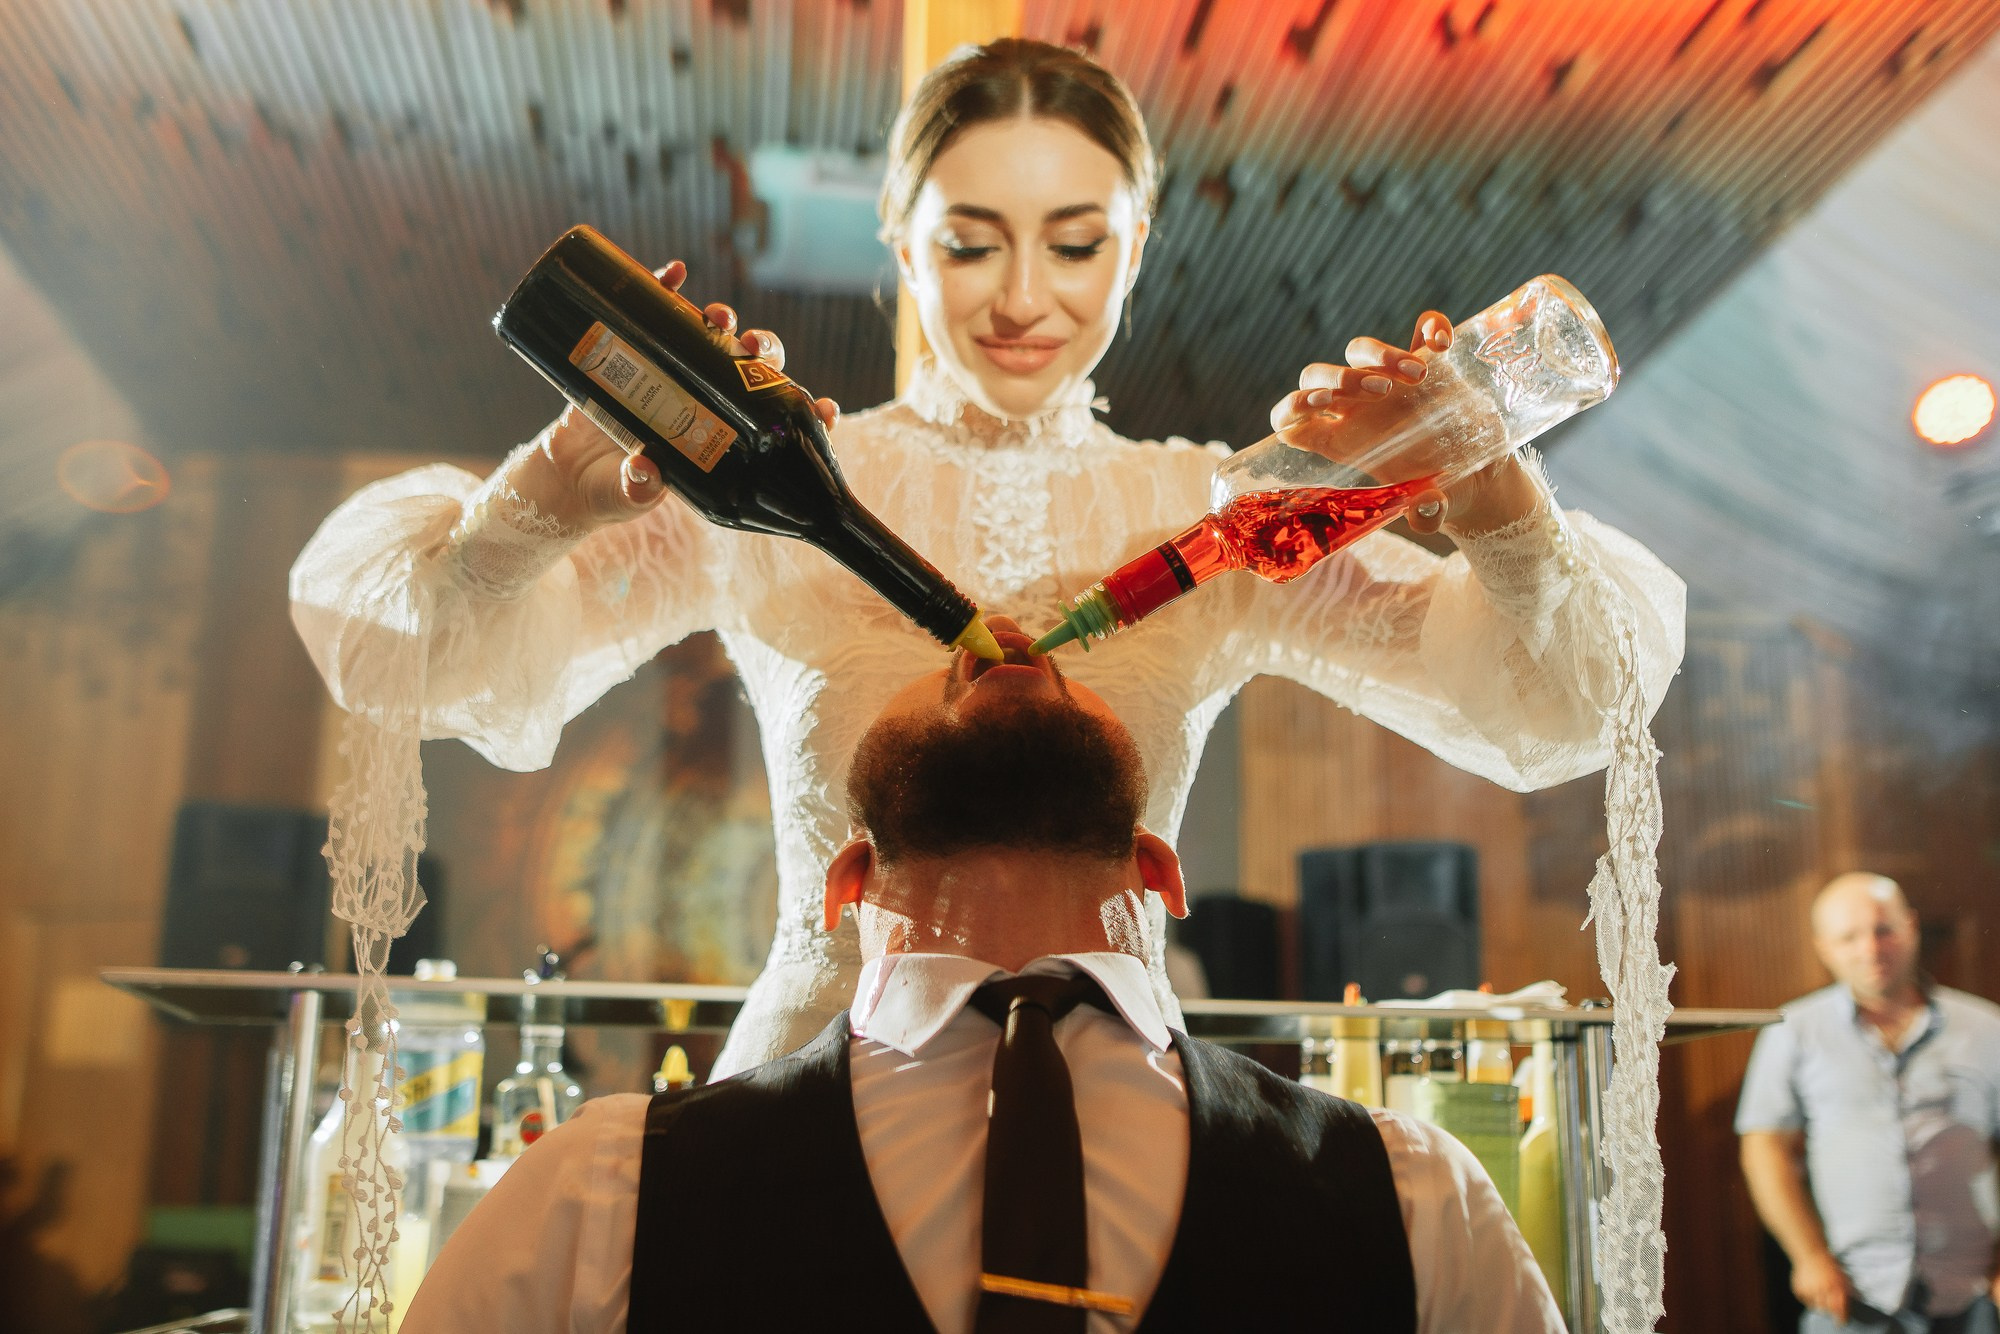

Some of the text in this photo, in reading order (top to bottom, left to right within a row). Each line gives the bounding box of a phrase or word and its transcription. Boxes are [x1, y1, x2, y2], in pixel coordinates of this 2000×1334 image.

[639, 384, 655, 403] МАРКА
[640, 383, 663, 410] АКЦИЗНАЯ
[701, 430, 729, 464] РОССИЙСКАЯ
